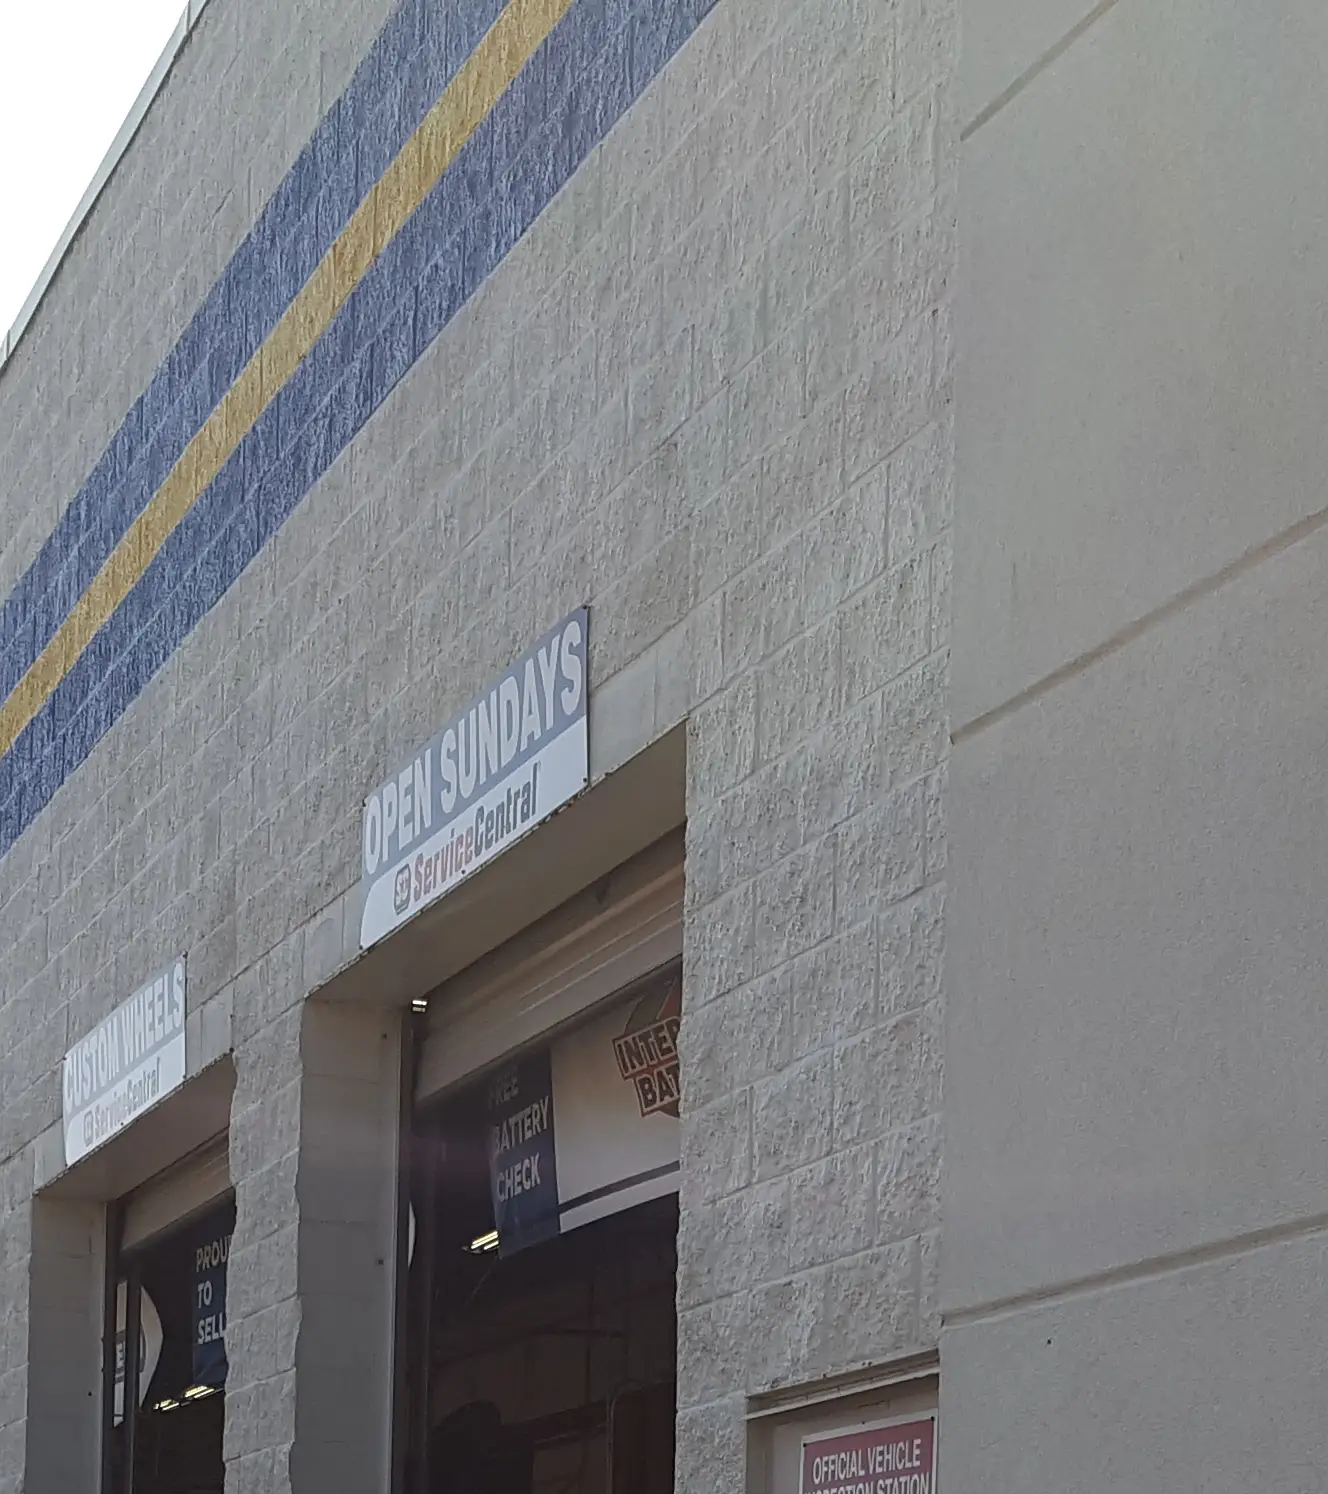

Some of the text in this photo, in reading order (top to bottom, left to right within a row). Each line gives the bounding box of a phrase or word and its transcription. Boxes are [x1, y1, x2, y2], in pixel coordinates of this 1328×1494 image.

[364, 620, 583, 876] OPEN SUNDAYS
[412, 760, 541, 902] ServiceCentral
[63, 962, 184, 1116] CUSTOM WHEELS
[493, 1095, 549, 1153] BATTERY
[496, 1151, 541, 1202] CHECK
[197, 1280, 213, 1309] TO
[197, 1311, 226, 1345] SELL
[812, 1438, 922, 1485] OFFICIAL VEHICLE
